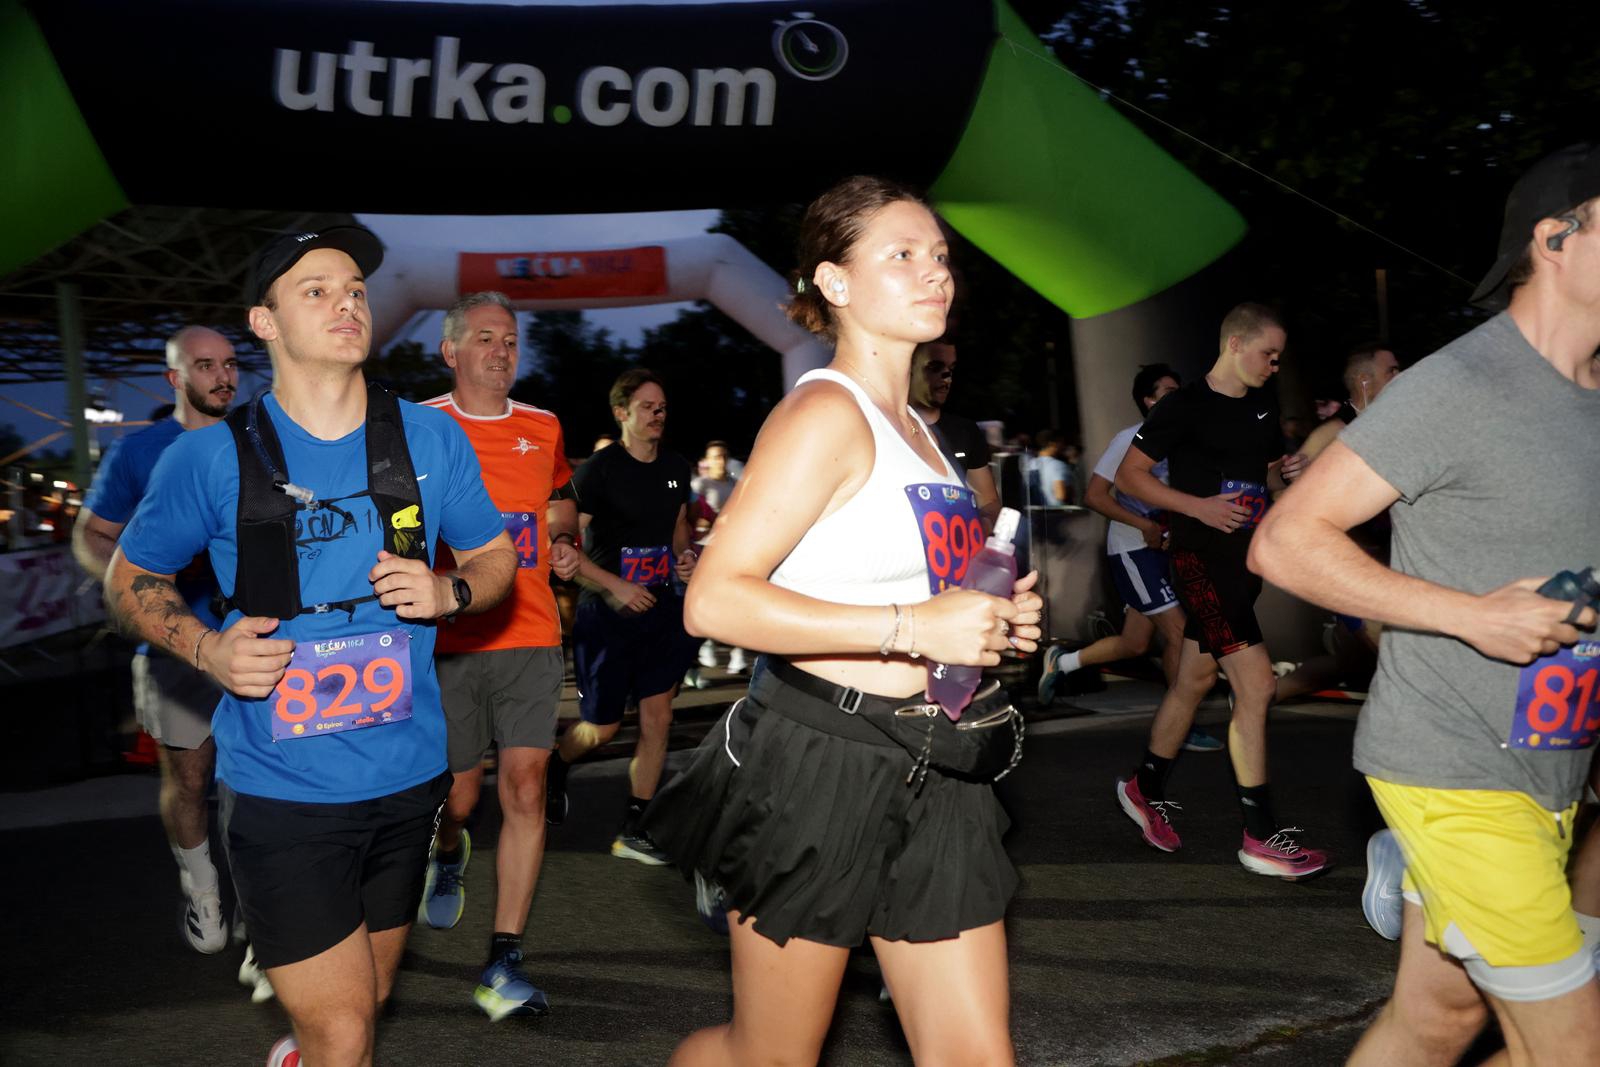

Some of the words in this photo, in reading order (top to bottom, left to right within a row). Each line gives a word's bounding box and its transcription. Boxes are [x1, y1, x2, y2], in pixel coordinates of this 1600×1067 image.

[274, 36, 776, 126] utrka.com
[623, 554, 670, 581] 754
[275, 657, 405, 723] 829
[1526, 664, 1600, 734] 81
